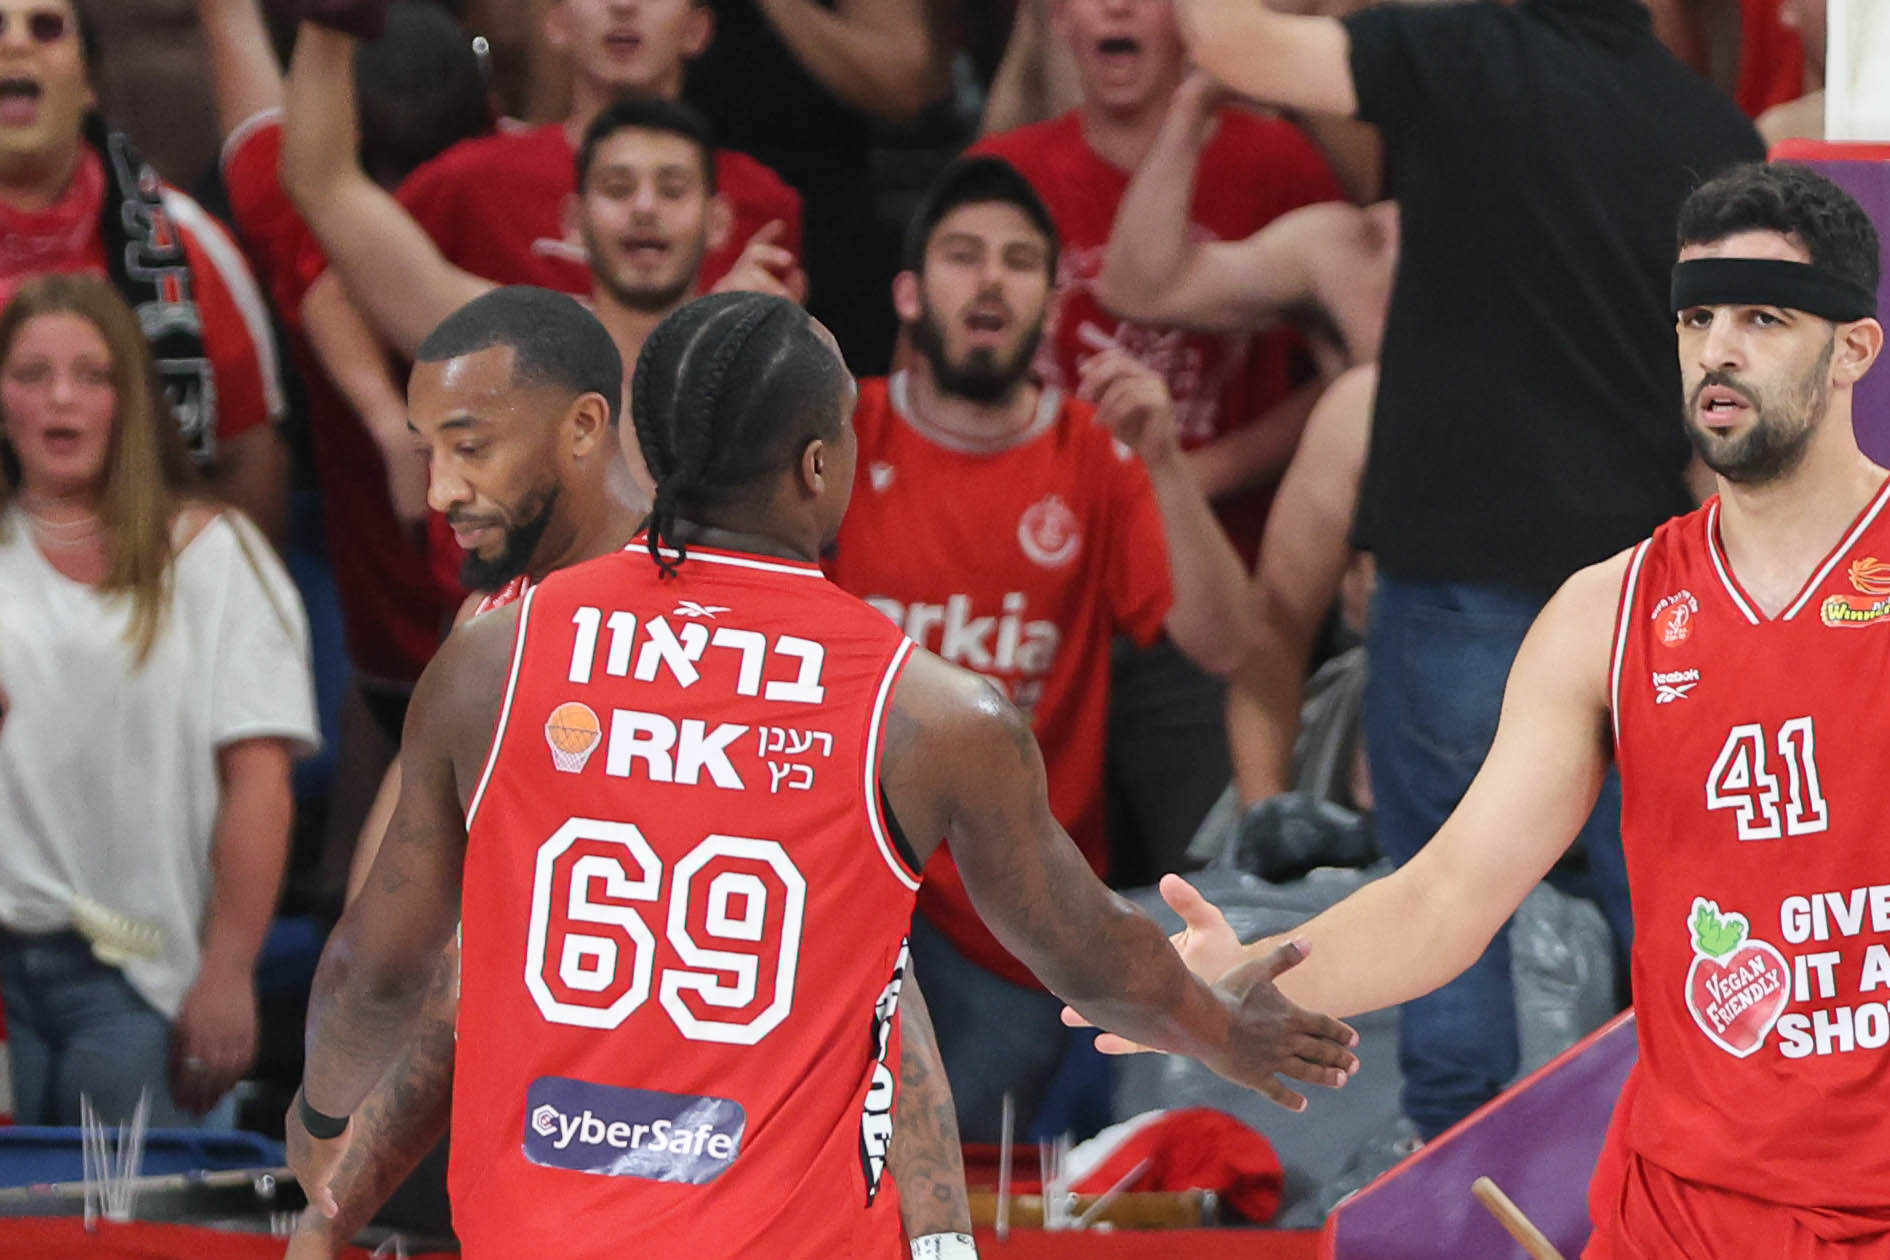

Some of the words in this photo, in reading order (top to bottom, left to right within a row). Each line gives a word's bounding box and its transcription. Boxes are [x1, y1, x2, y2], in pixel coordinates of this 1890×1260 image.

[569, 606, 826, 704] בראון
[606, 708, 750, 790] RK
[758, 726, 834, 757] רענן
[767, 760, 814, 793] כץ
[1704, 715, 1829, 841] 41
[524, 817, 808, 1046] 69
[1705, 954, 1767, 1005] VEGAN
[1706, 968, 1781, 1034] FRIENDLY
[1794, 951, 1841, 1002] IT
[531, 1103, 733, 1160] CyberSafe
